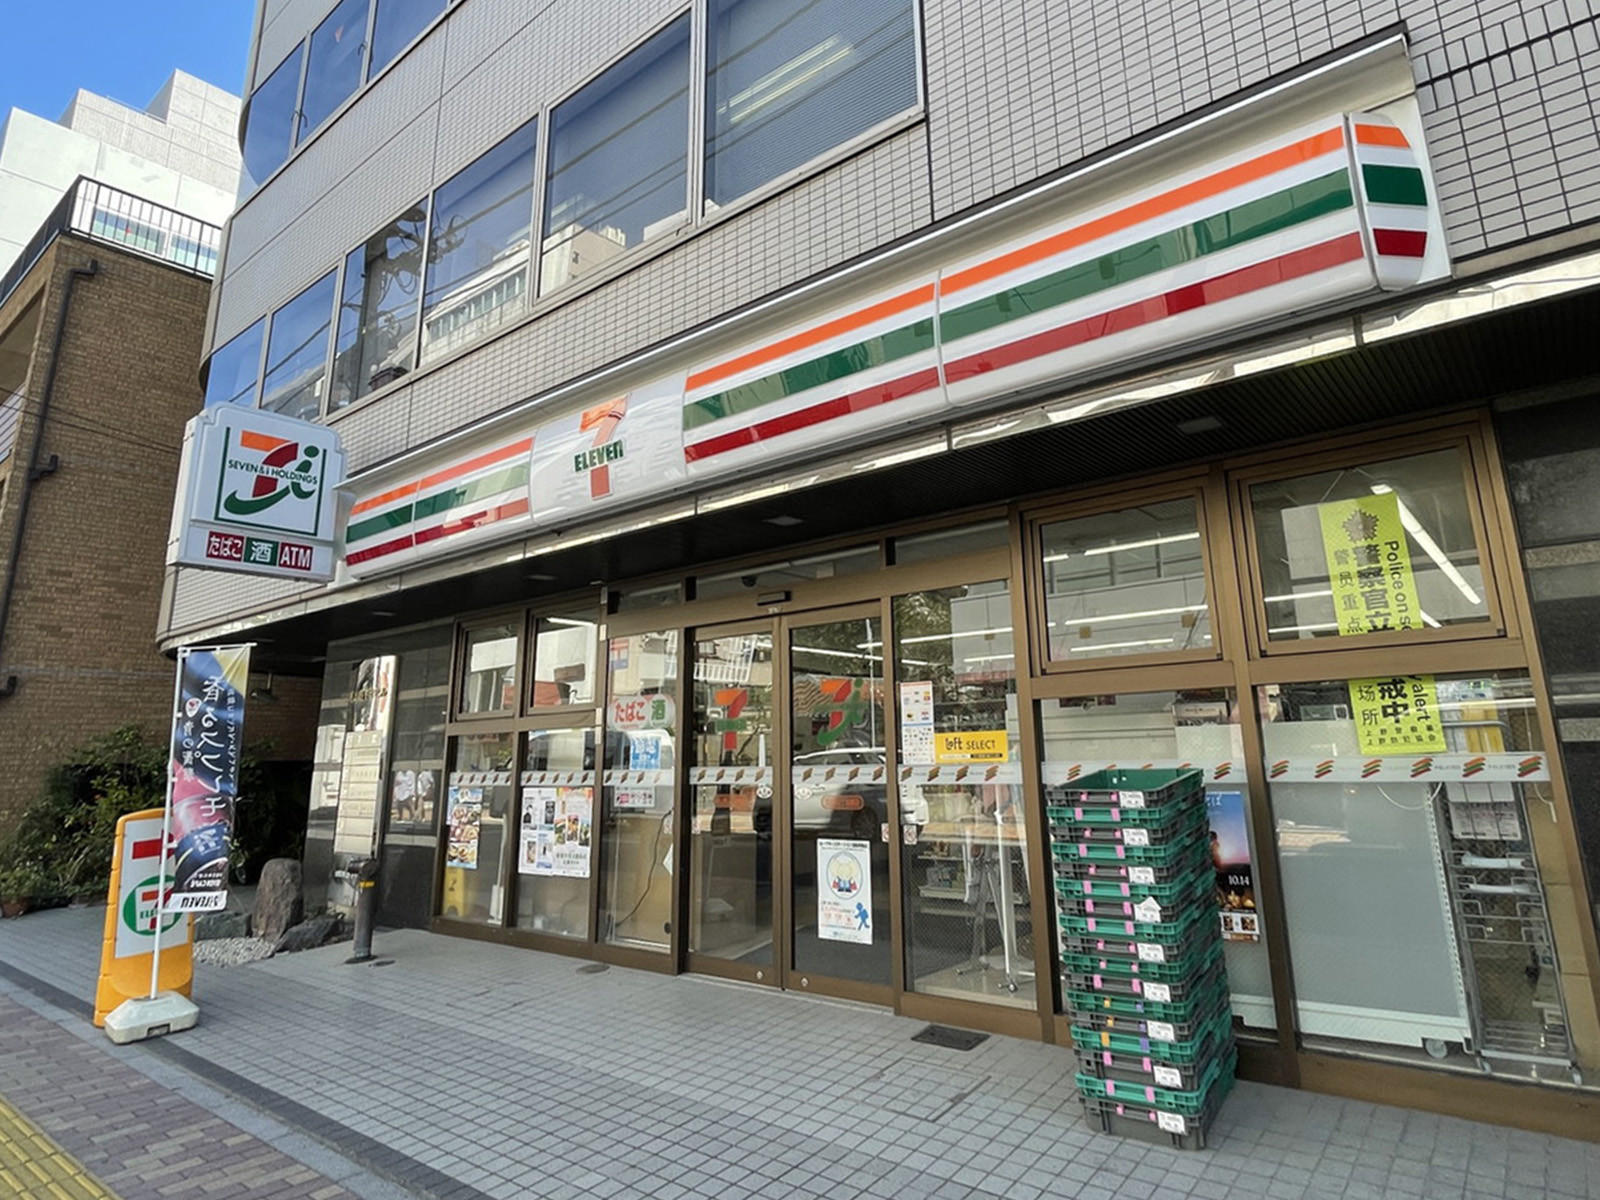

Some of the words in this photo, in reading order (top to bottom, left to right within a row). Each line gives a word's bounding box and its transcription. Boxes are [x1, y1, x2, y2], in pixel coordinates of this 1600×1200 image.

[271, 468, 318, 485] HOLDINGS
[208, 535, 243, 558] たばこ
[249, 541, 274, 562] 酒
[280, 546, 312, 568] ATM
[1384, 540, 1404, 590] Police
[1394, 592, 1408, 613] on
[1411, 683, 1432, 722] alert
[614, 699, 646, 723] たばこ
[651, 699, 667, 721] 酒
[966, 739, 996, 750] SELECT
[1228, 874, 1250, 887] 10.14
